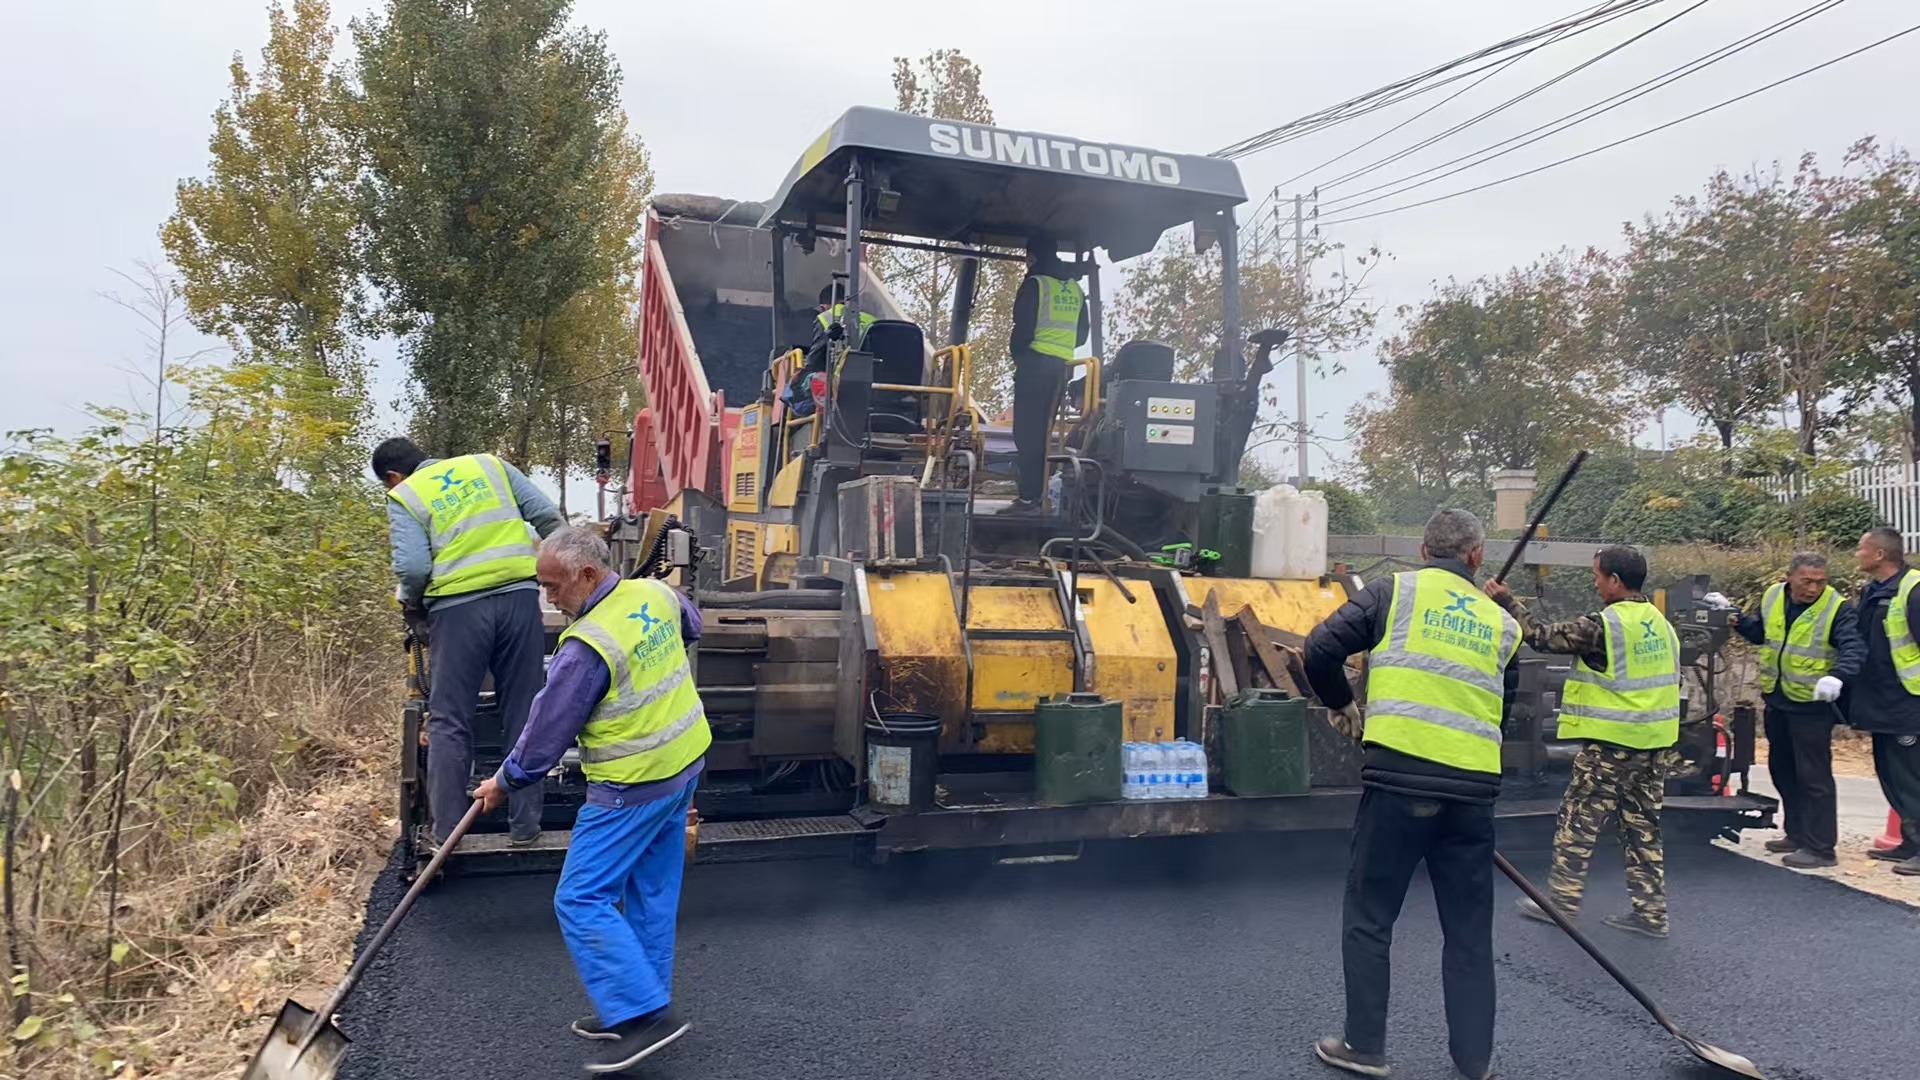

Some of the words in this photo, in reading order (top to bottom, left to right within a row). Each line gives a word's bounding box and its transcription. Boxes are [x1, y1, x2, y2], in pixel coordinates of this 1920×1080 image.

[928, 123, 1181, 185] SUMITOMO
[431, 477, 488, 513] 信创工程
[634, 619, 675, 660] 信创建筑
[1424, 608, 1493, 641] 信创建筑
